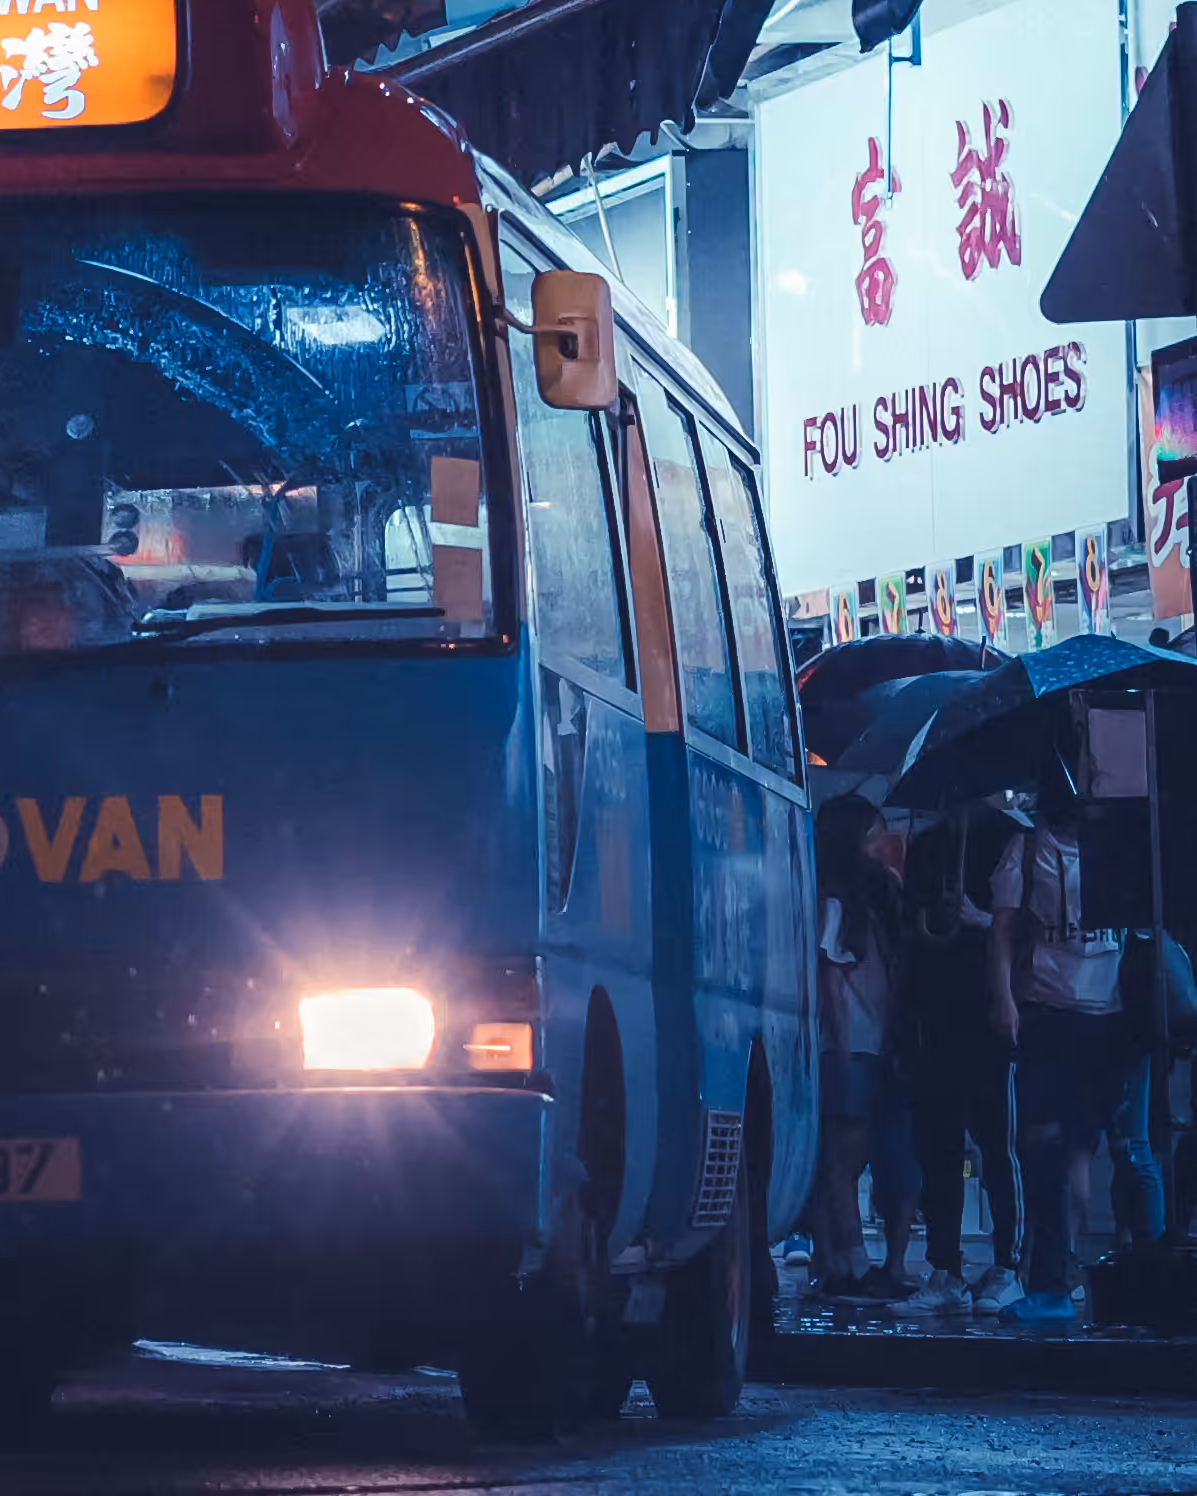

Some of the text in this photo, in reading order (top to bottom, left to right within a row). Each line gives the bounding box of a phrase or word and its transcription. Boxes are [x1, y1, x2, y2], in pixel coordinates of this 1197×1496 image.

[803, 340, 1087, 480] FOU SHING SHOES
